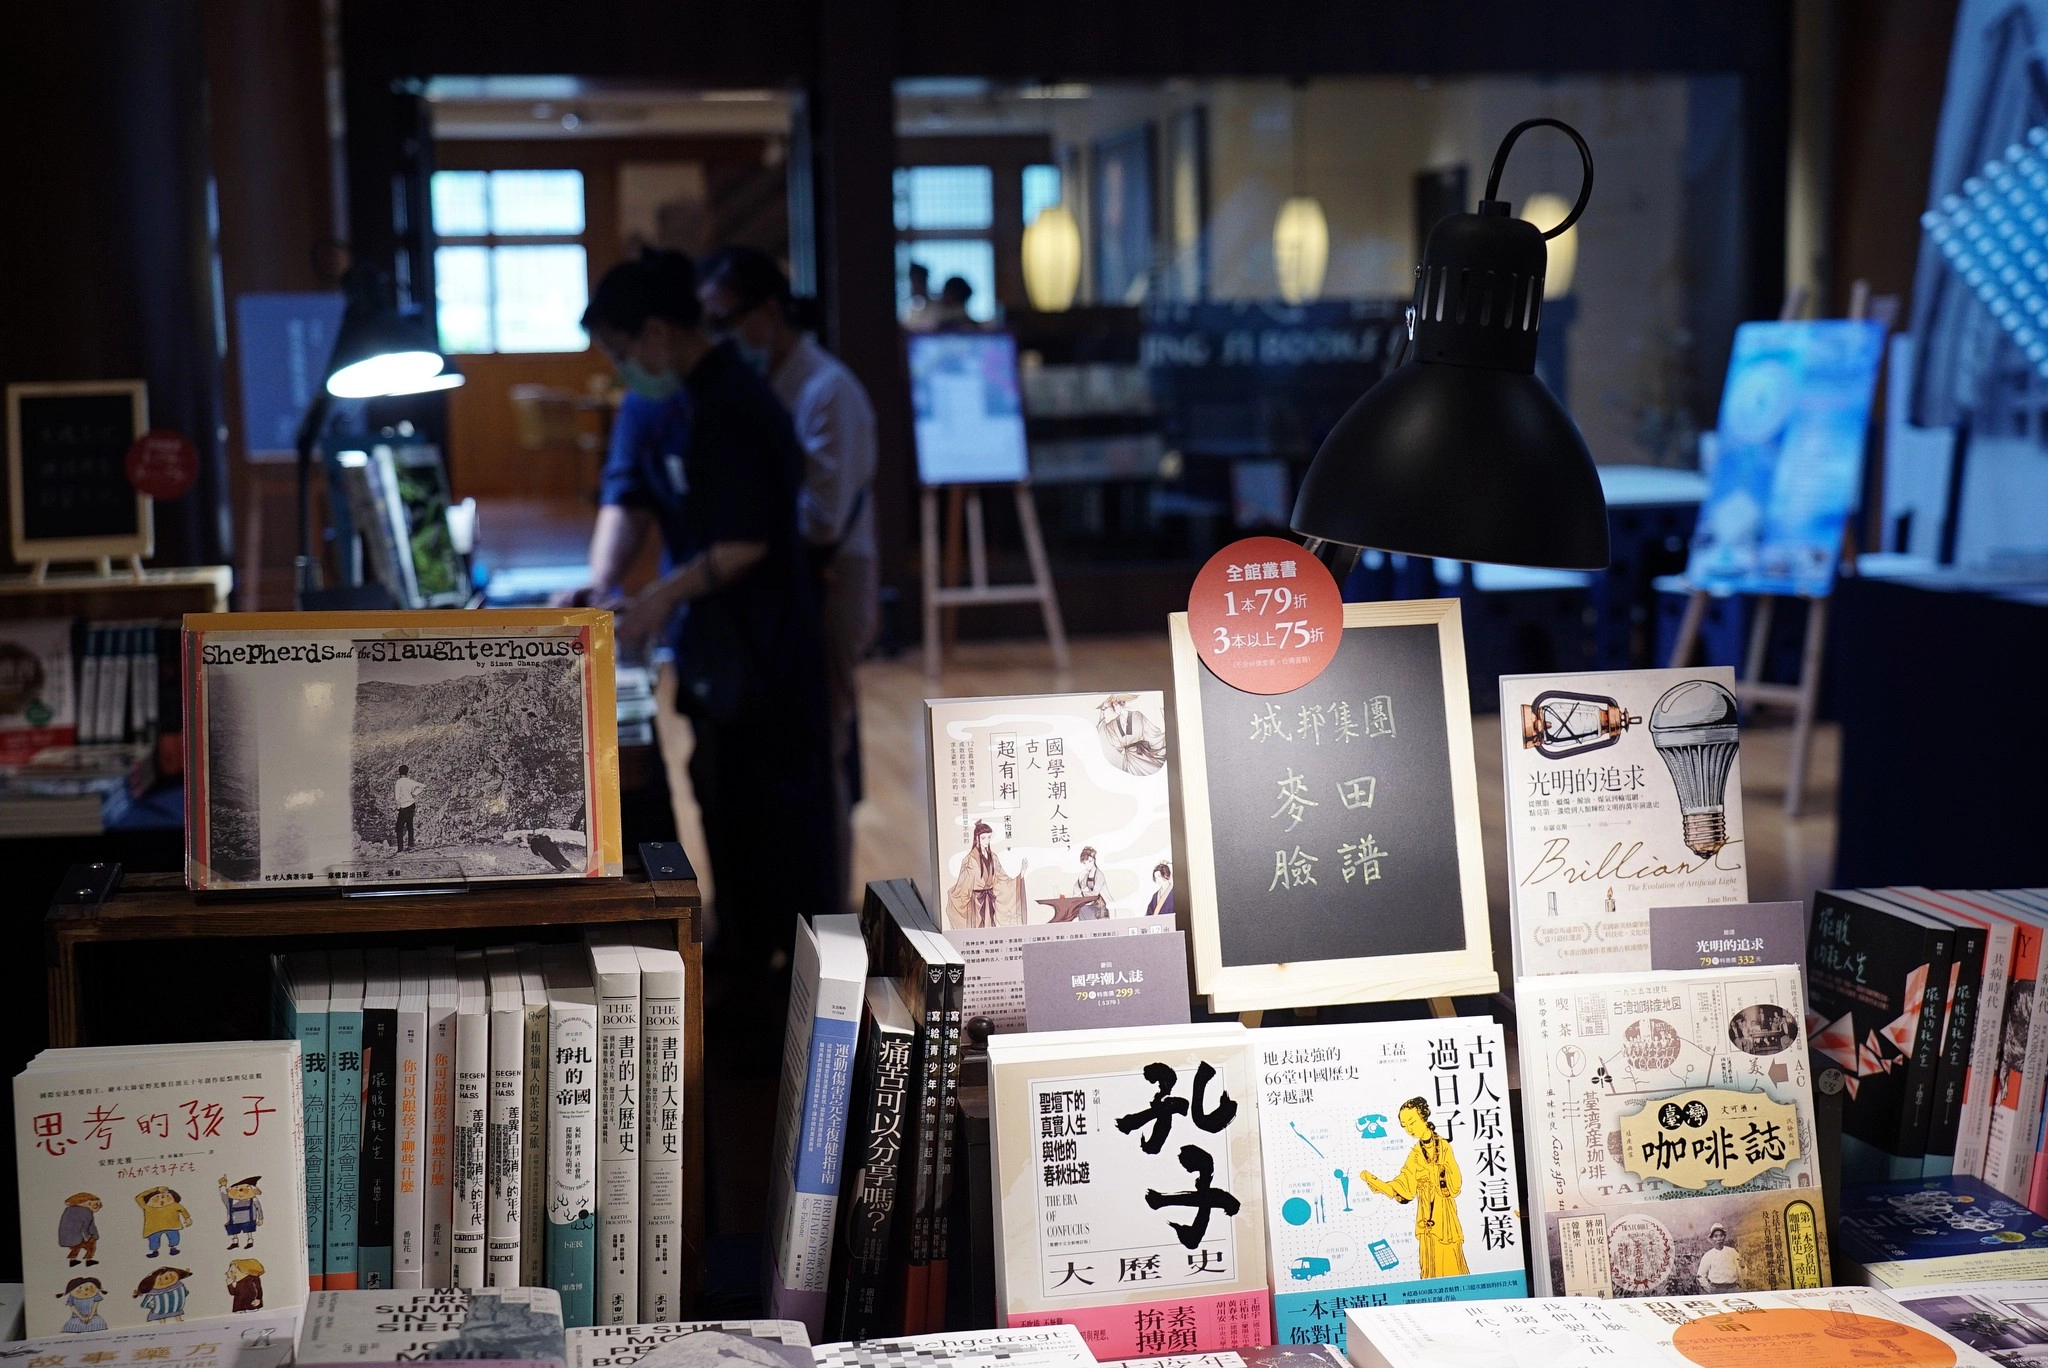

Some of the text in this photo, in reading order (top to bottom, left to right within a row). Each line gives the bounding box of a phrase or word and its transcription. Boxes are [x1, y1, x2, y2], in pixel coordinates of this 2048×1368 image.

[1226, 560, 1298, 582] 全館叢書
[1224, 587, 1308, 617] 1本79折
[1213, 620, 1325, 655] 3本以上75折
[202, 639, 584, 665] Shepherds and the Slaughterhouse
[517, 660, 541, 668] Chang
[1250, 695, 1396, 745] 城邦集團
[1025, 739, 1042, 770] 古人
[996, 740, 1018, 800] 超有料
[1527, 764, 1646, 798] 光明的追求
[1270, 767, 1377, 832] 麥田
[1003, 815, 1012, 839] 宋怡慧
[1268, 833, 1389, 892] 臉譜
[1642, 881, 1676, 891] Evolution
[1686, 878, 1717, 888] Artificial
[1718, 876, 1737, 888] Light
[1696, 938, 1765, 953] 光明的追求
[1071, 970, 1144, 988] 國學潮人誌
[603, 1015, 636, 1025] BOOK
[606, 1004, 633, 1014] THE
[646, 1016, 679, 1026] BOOK
[649, 1005, 676, 1015] THE
[556, 1046, 592, 1065] 掙扎
[1263, 1047, 1341, 1066] 地表最強的
[1378, 1041, 1406, 1057] 王磊
[459, 1072, 486, 1080] GEGEN
[459, 1083, 477, 1091] DEN
[566, 1068, 583, 1085] 的
[1264, 1066, 1360, 1086] 66堂中國歷史
[529, 1031, 541, 1149] 植物獵人的茶盜之旅
[556, 1088, 591, 1106] 帝國
[618, 1035, 635, 1154] 書的大歷史
[661, 1036, 679, 1155] 書的大歷史
[1039, 1089, 1086, 1114] 聖壇下的
[1267, 1088, 1314, 1105] 穿越課
[1427, 1037, 1465, 1143] 過日子
[34, 1096, 276, 1156] 思考的孩子
[401, 1060, 417, 1193] 你可以跟孩子聊些什麼
[431, 1053, 448, 1187] 你可以跟孩子聊些什麼
[821, 1043, 850, 1185] 運動傷害完全復健指南
[1041, 1113, 1088, 1139] 真實人生
[1660, 1102, 1707, 1128] 臺灣
[863, 1039, 912, 1232] 痛苦可以分享嗎？
[1464, 1035, 1515, 1251] 古人原來這樣
[1642, 1121, 1786, 1170] 咖啡誌
[1042, 1138, 1077, 1163] 與他的
[1115, 1061, 1241, 1250] 孔子
[117, 1161, 196, 1180] かんがえる子ども
[1043, 1161, 1091, 1187] 春秋壯遊
[1045, 1194, 1079, 1208] THE ERA
[1046, 1210, 1057, 1223] OF
[403, 1231, 412, 1253] 番紅花
[433, 1223, 441, 1246] 番紅花
[454, 1233, 484, 1241] CAROLIN
[1047, 1224, 1090, 1238] CONFUCIUS
[803, 1247, 817, 1290] PERFOR
[1050, 1249, 1228, 1290] 大歷史
[589, 1327, 641, 1337] THE
[1134, 1309, 1167, 1353] 拚搏
[1167, 1305, 1197, 1353] 素顏
